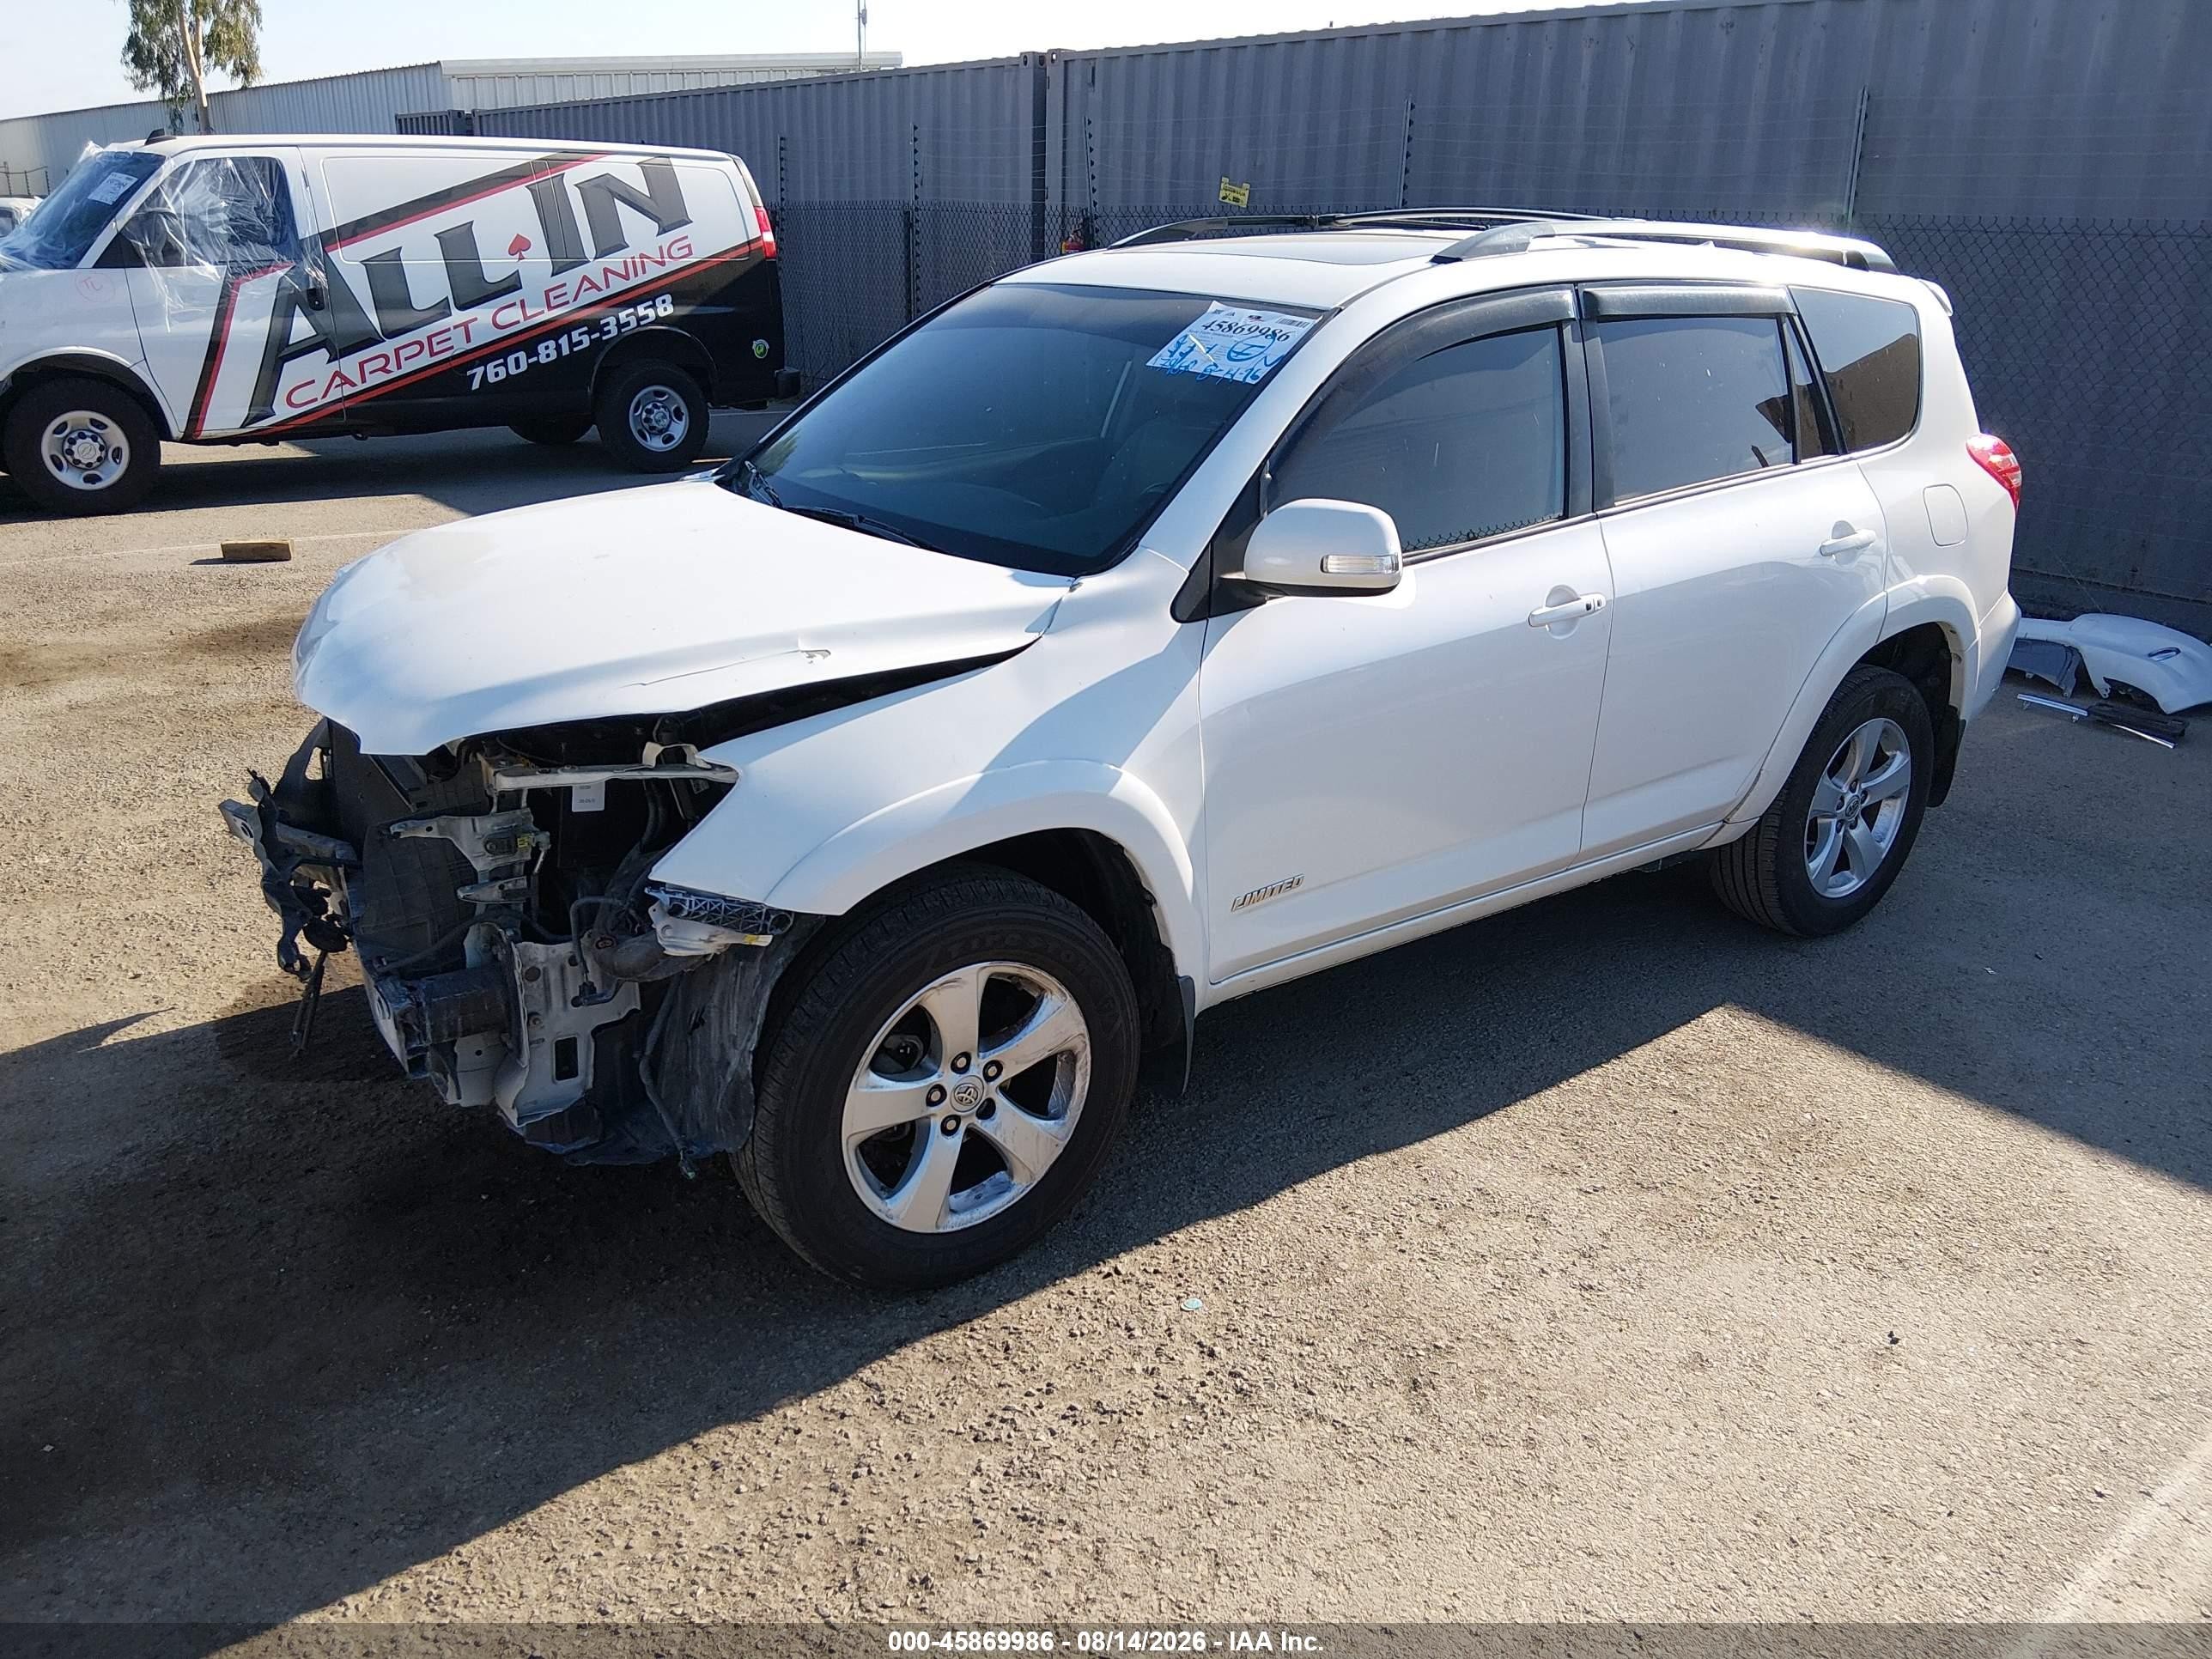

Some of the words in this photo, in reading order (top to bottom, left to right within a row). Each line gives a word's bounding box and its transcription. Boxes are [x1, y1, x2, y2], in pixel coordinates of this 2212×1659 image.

[242, 221, 522, 428] ALL
[526, 157, 694, 277] IN
[285, 317, 479, 410] CARPET
[491, 235, 694, 331] CLEANING
[1202, 320, 1291, 342] 45869986
[467, 294, 674, 392] 760-815-3558
[1231, 872, 1305, 911] LIMITED
